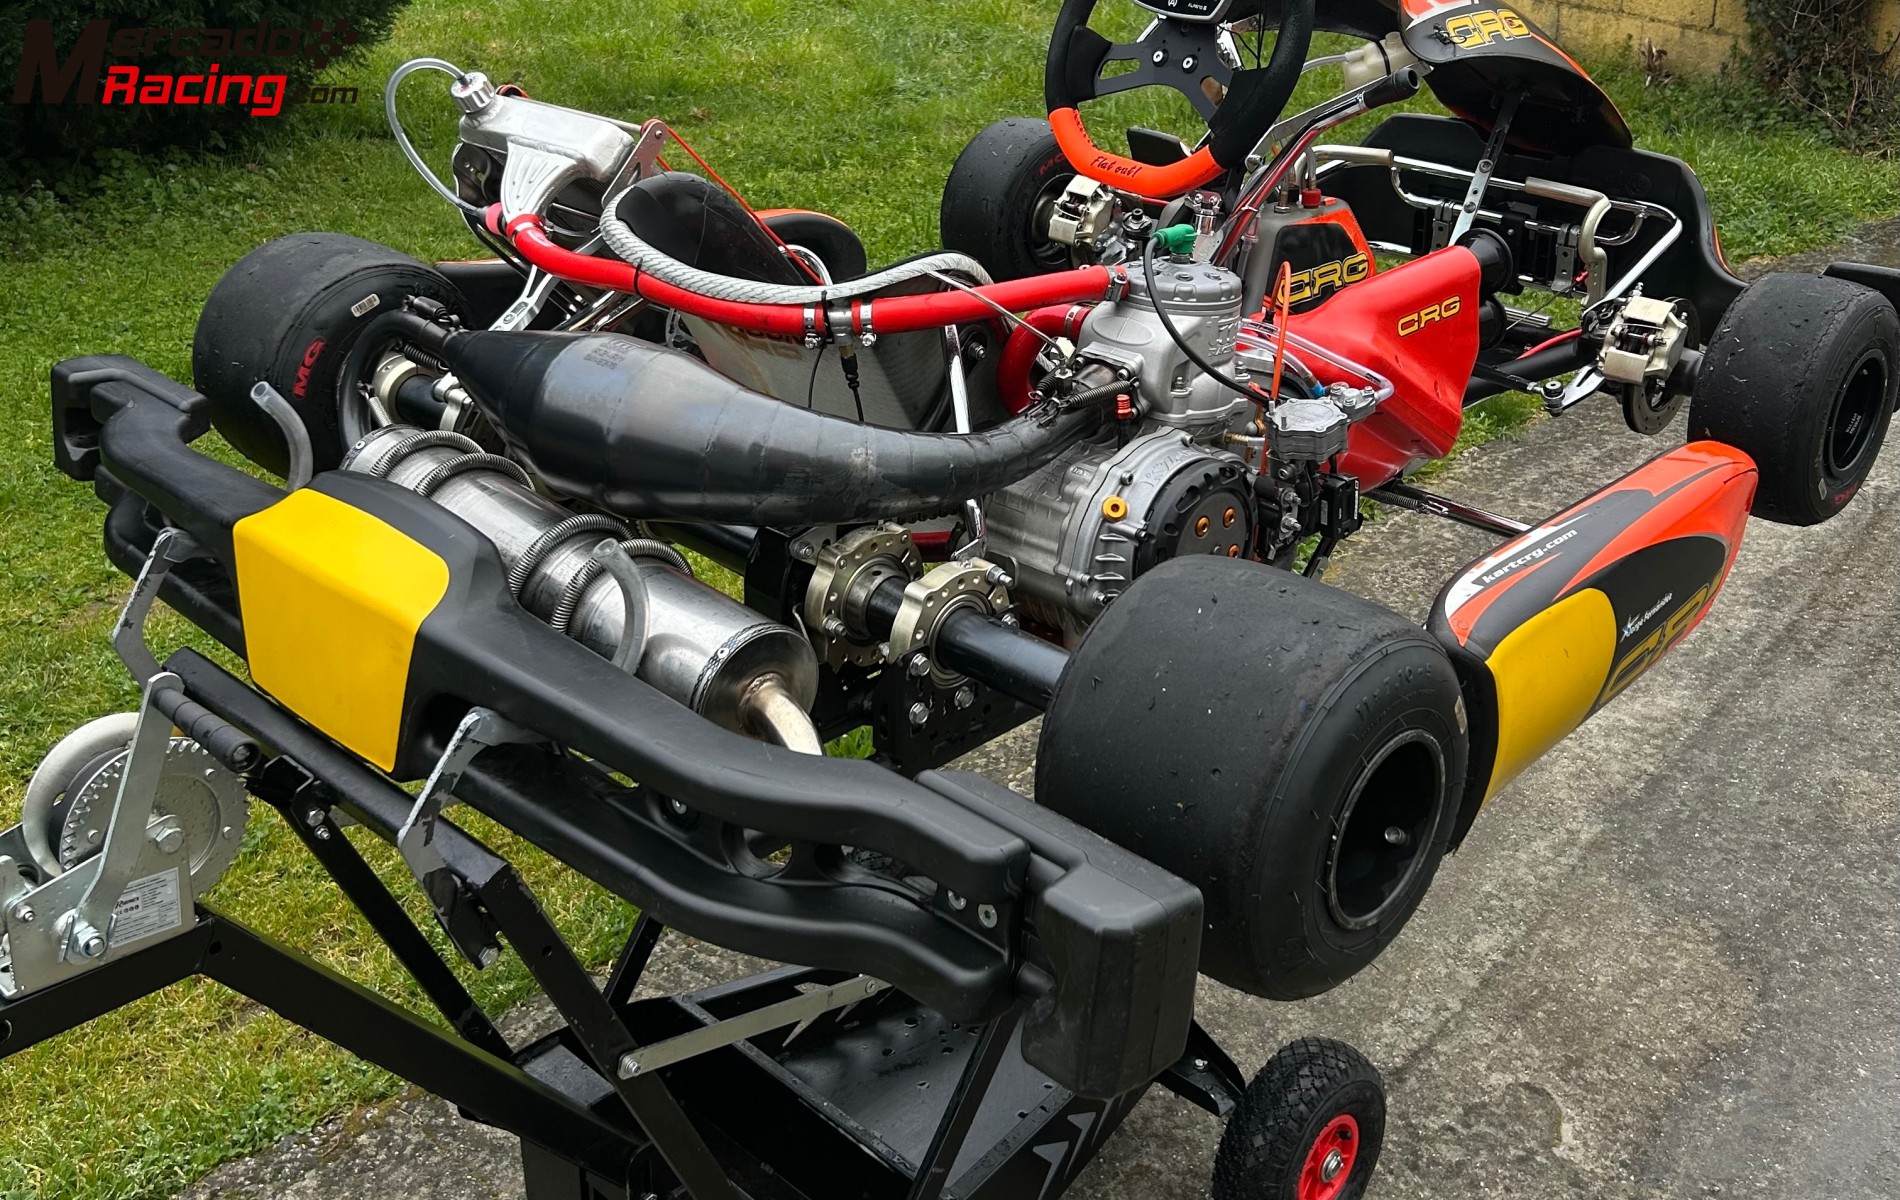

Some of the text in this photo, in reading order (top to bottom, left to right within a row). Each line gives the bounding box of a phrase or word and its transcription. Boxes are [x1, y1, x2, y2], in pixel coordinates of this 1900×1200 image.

[1445, 9, 1532, 50] CRG
[1090, 155, 1116, 171] Flat
[1276, 250, 1370, 307] CRG
[1397, 294, 1461, 338] CRG
[293, 339, 326, 397] MG
[1481, 529, 1578, 584] kartcrg.com
